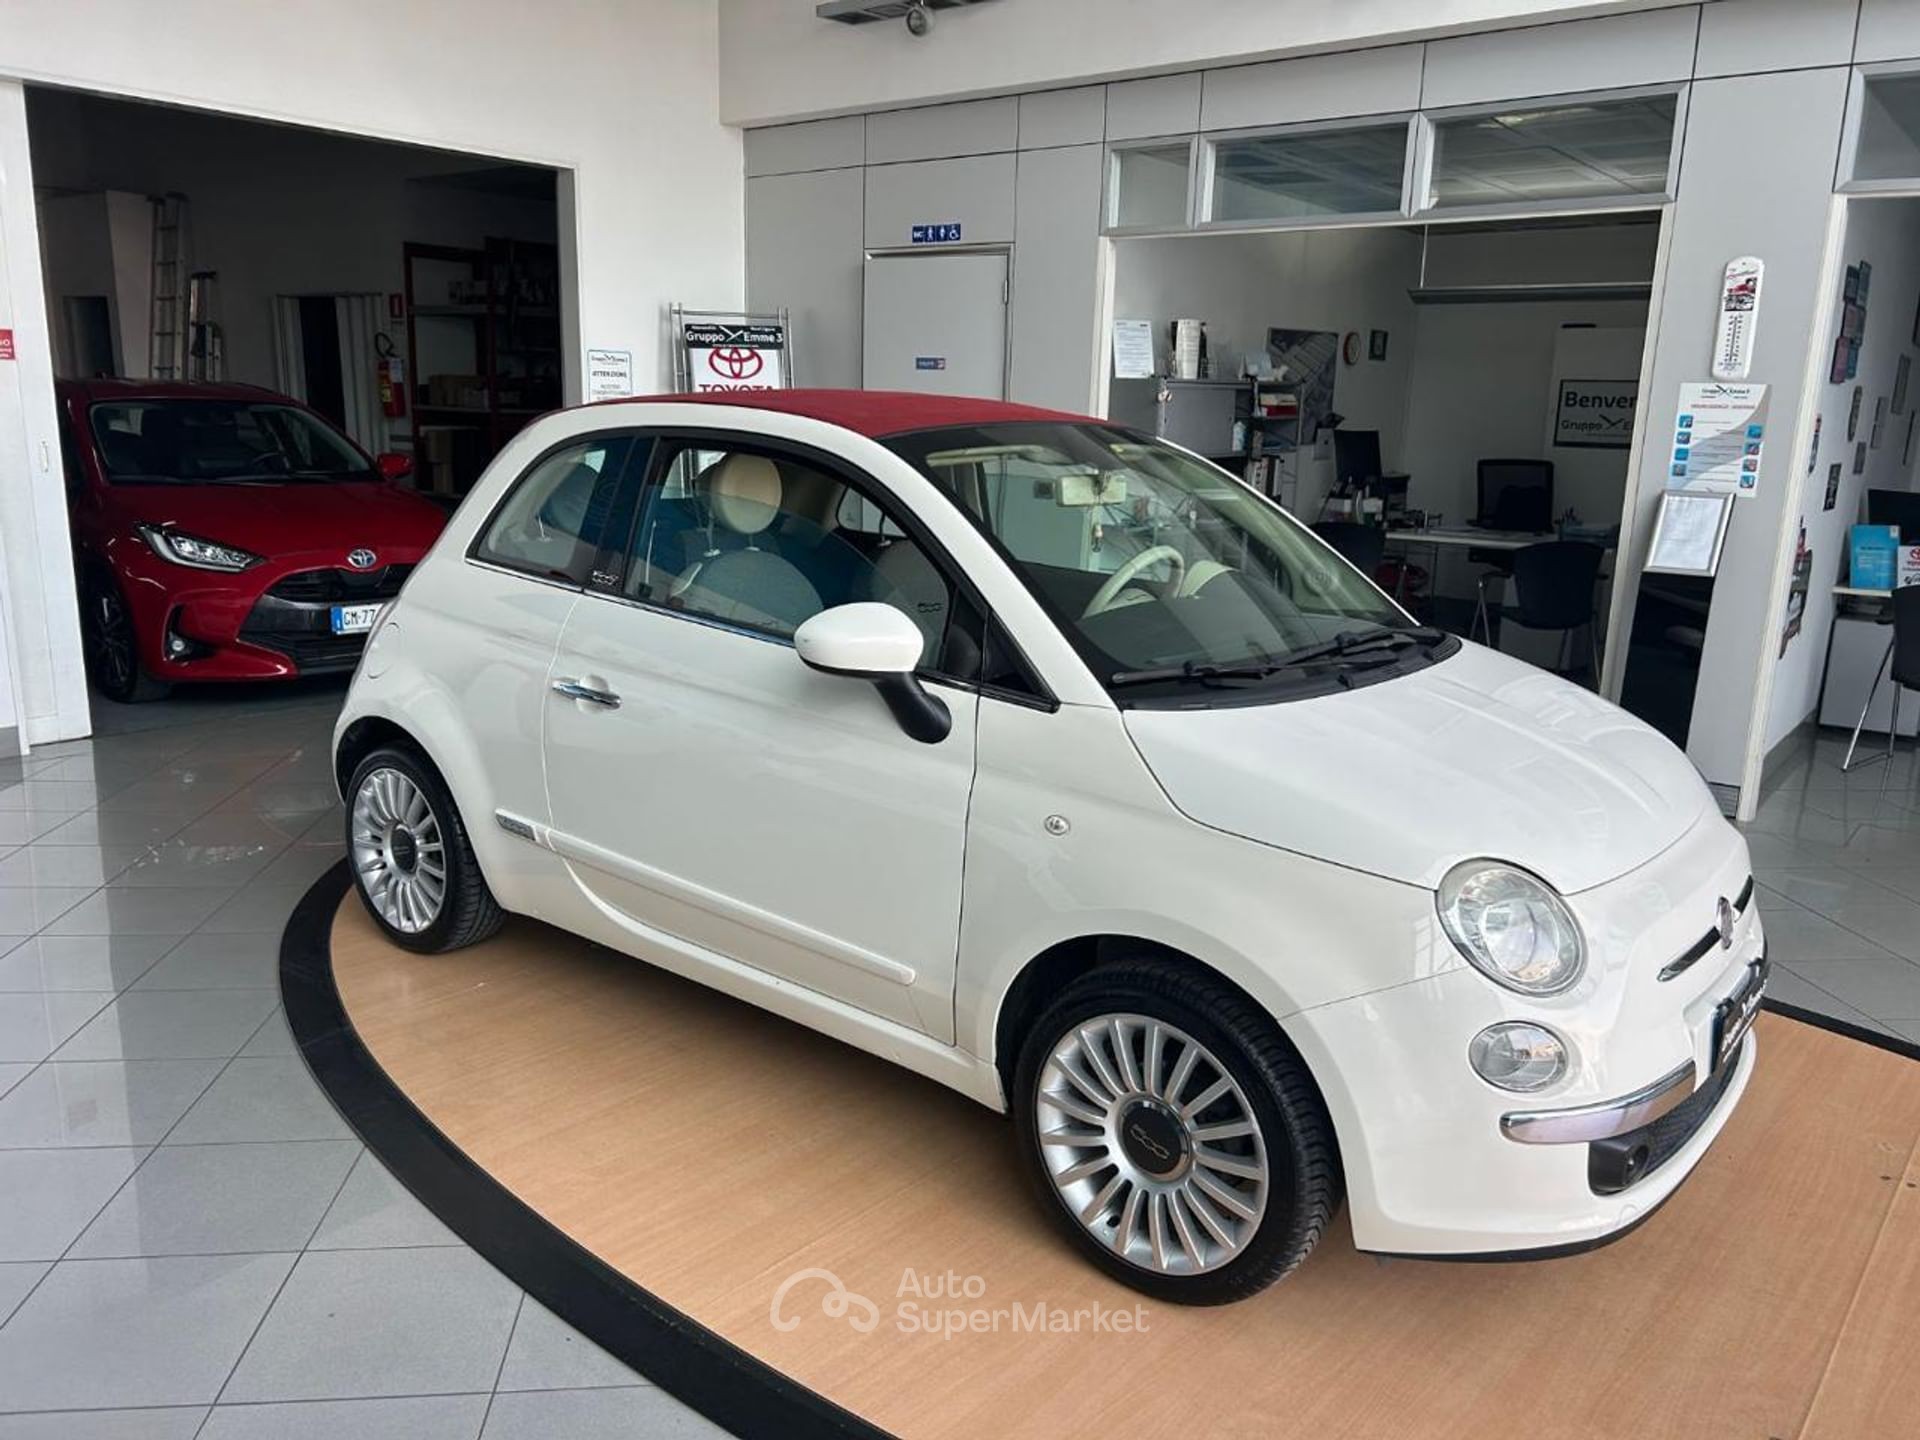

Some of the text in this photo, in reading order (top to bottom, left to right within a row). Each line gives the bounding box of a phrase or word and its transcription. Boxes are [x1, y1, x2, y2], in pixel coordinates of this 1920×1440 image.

[686, 331, 783, 343] Gruppo Emme 3
[1561, 420, 1603, 432] Gruppo
